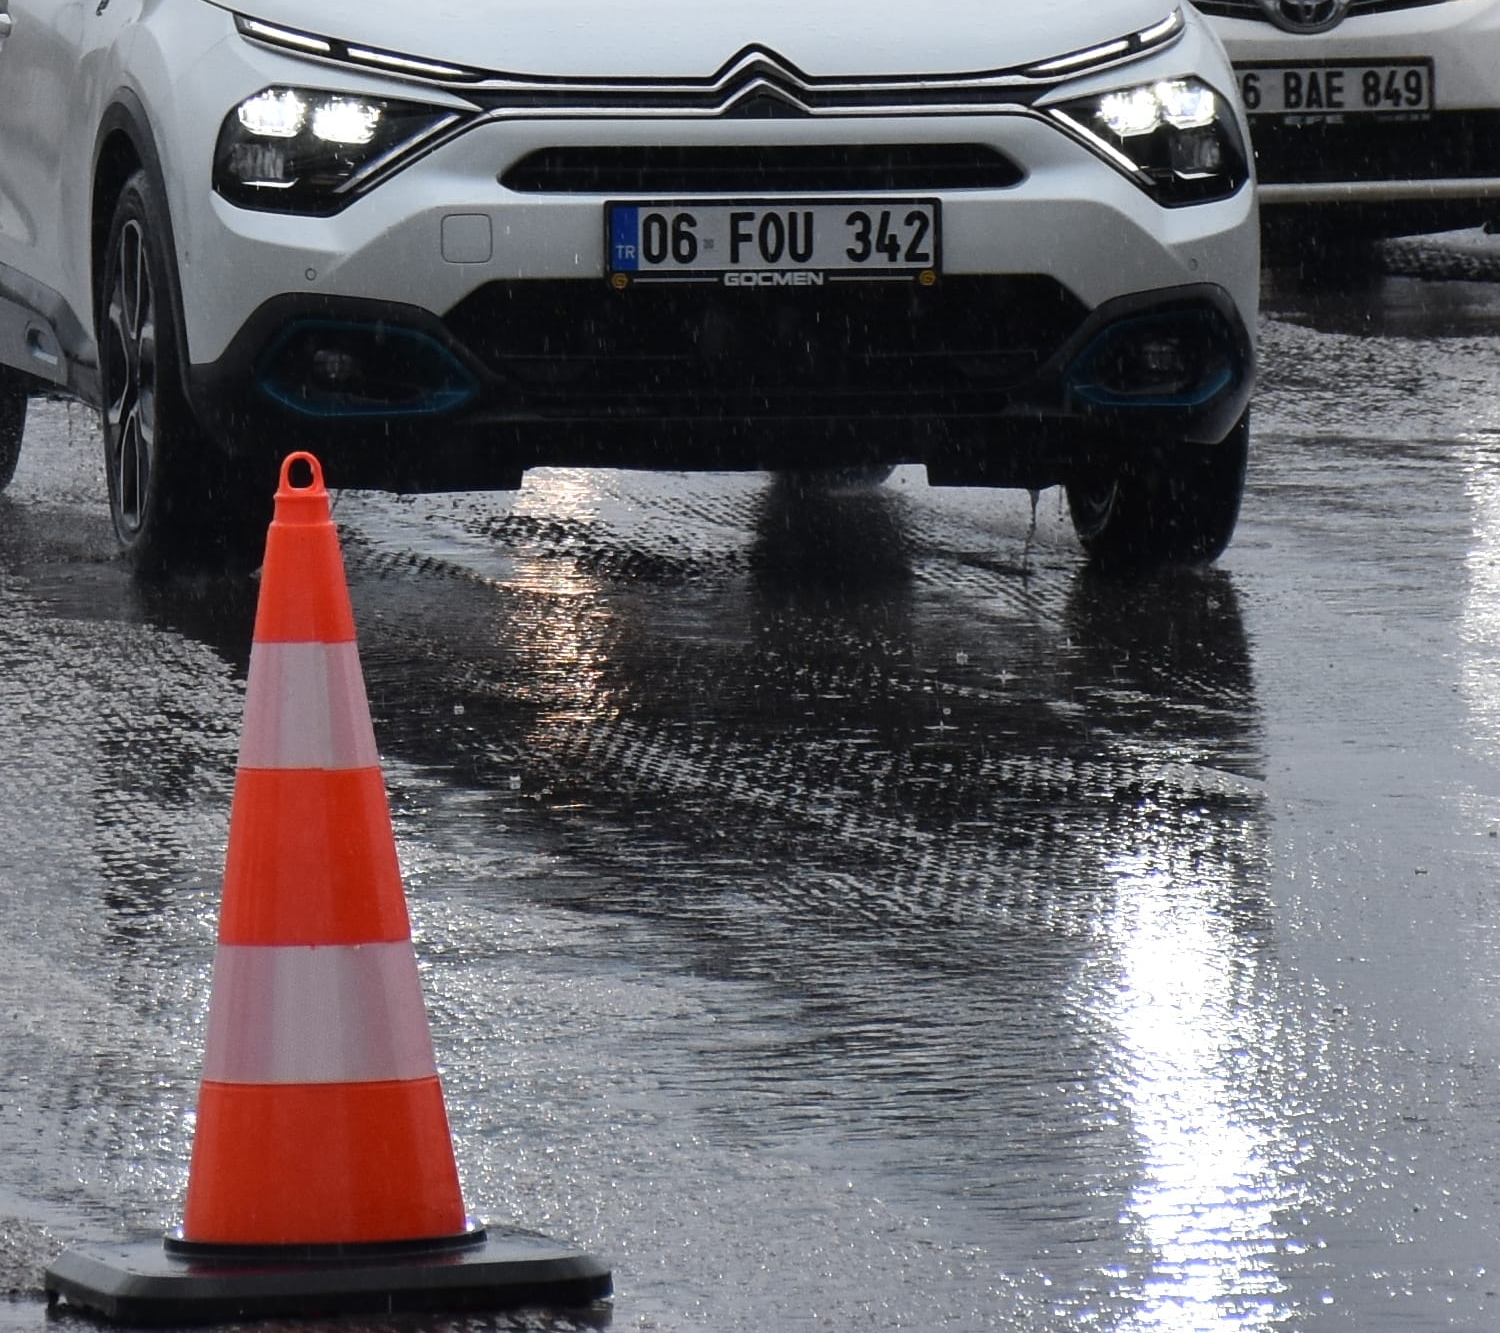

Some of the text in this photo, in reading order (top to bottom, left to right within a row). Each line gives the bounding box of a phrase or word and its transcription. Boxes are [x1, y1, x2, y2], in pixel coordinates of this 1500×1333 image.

[1237, 70, 1422, 110] 6 BAE 849
[616, 210, 930, 265] TR 06 FOU 342
